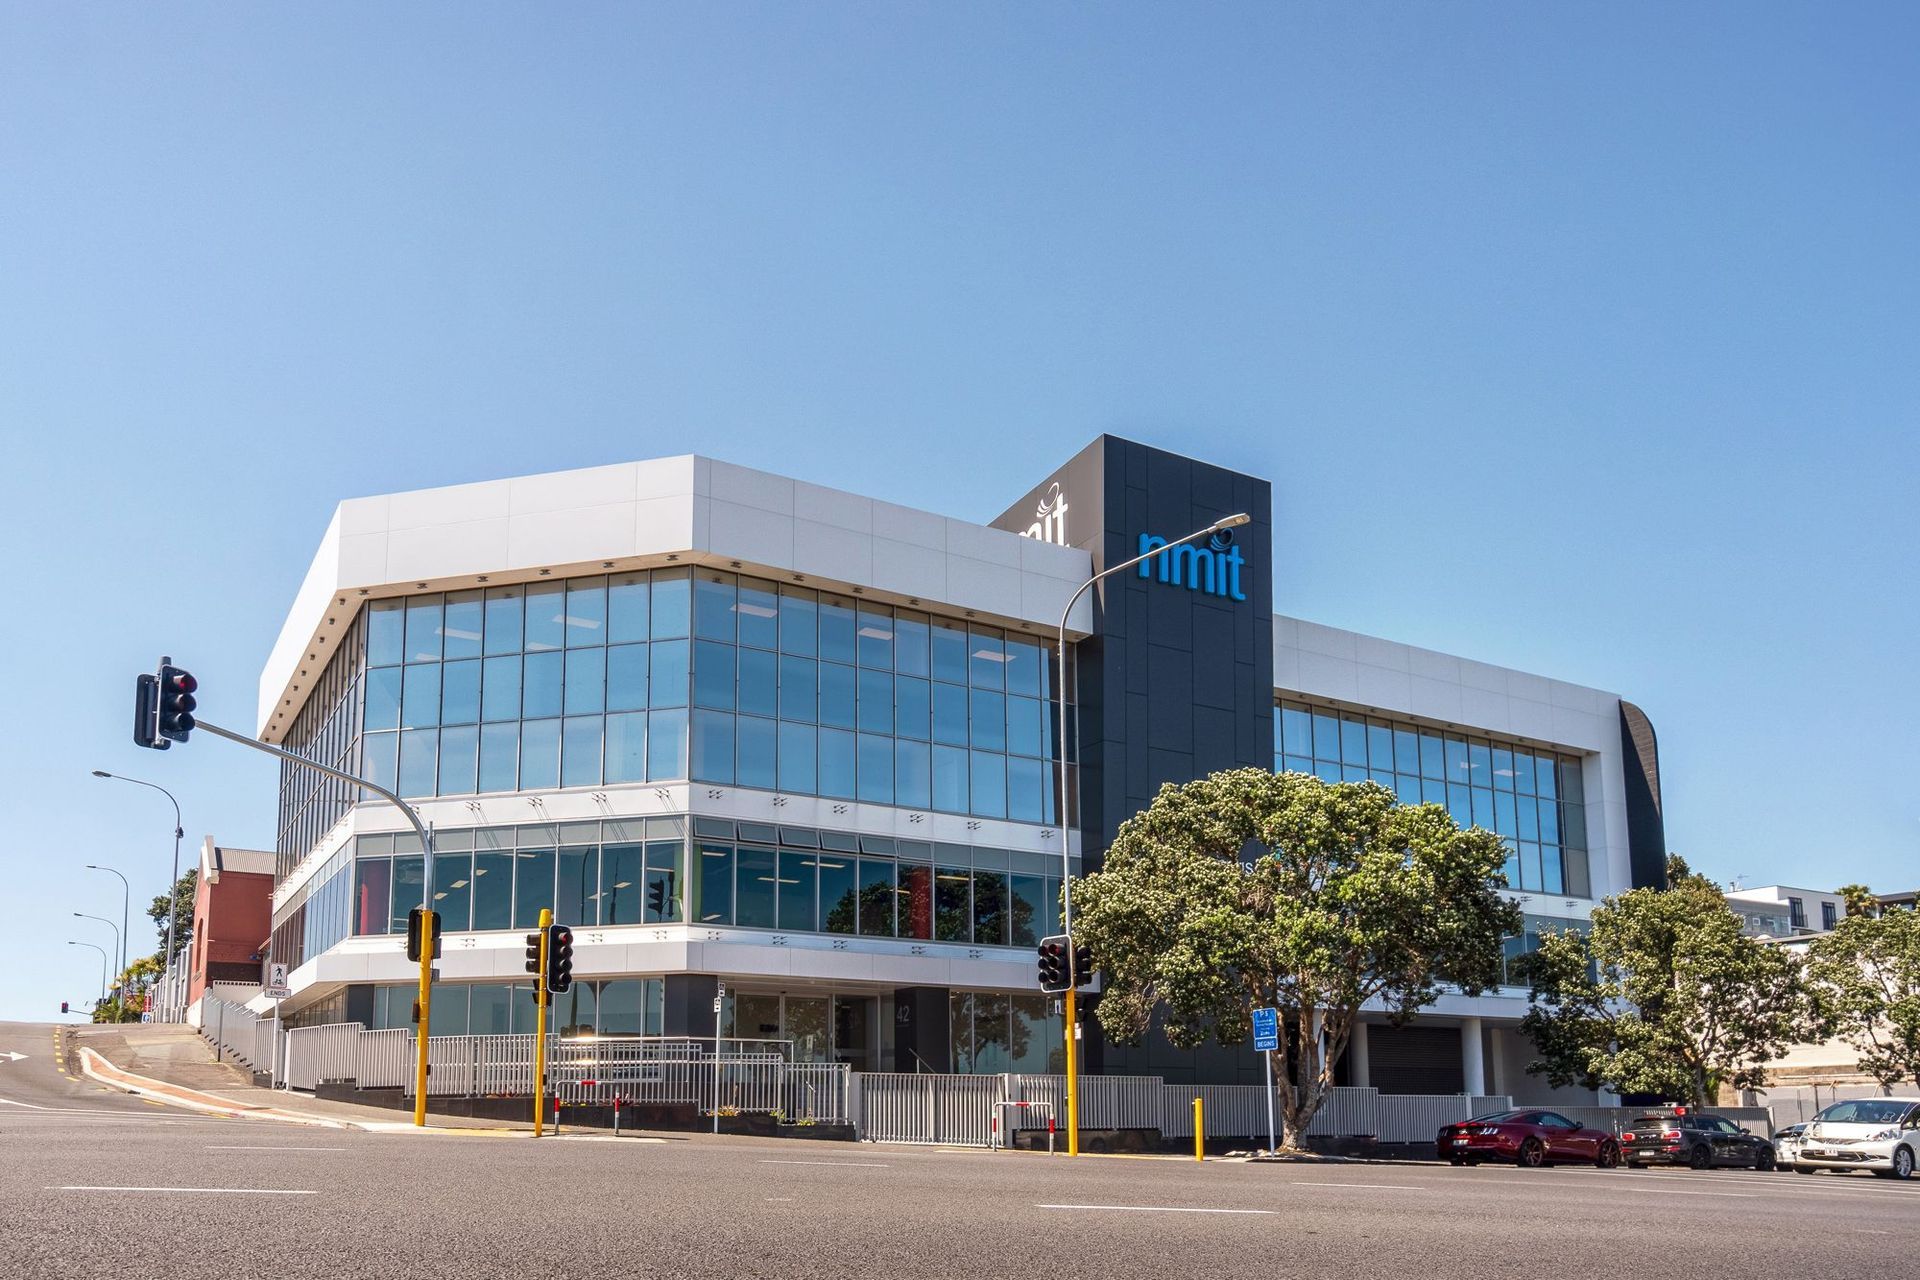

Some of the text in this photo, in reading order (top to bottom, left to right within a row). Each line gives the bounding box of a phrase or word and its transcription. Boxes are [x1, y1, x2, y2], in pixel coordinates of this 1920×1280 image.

[1137, 528, 1245, 601] nmit
[896, 1005, 910, 1022] 42
[1257, 1040, 1275, 1048] BEGINS
